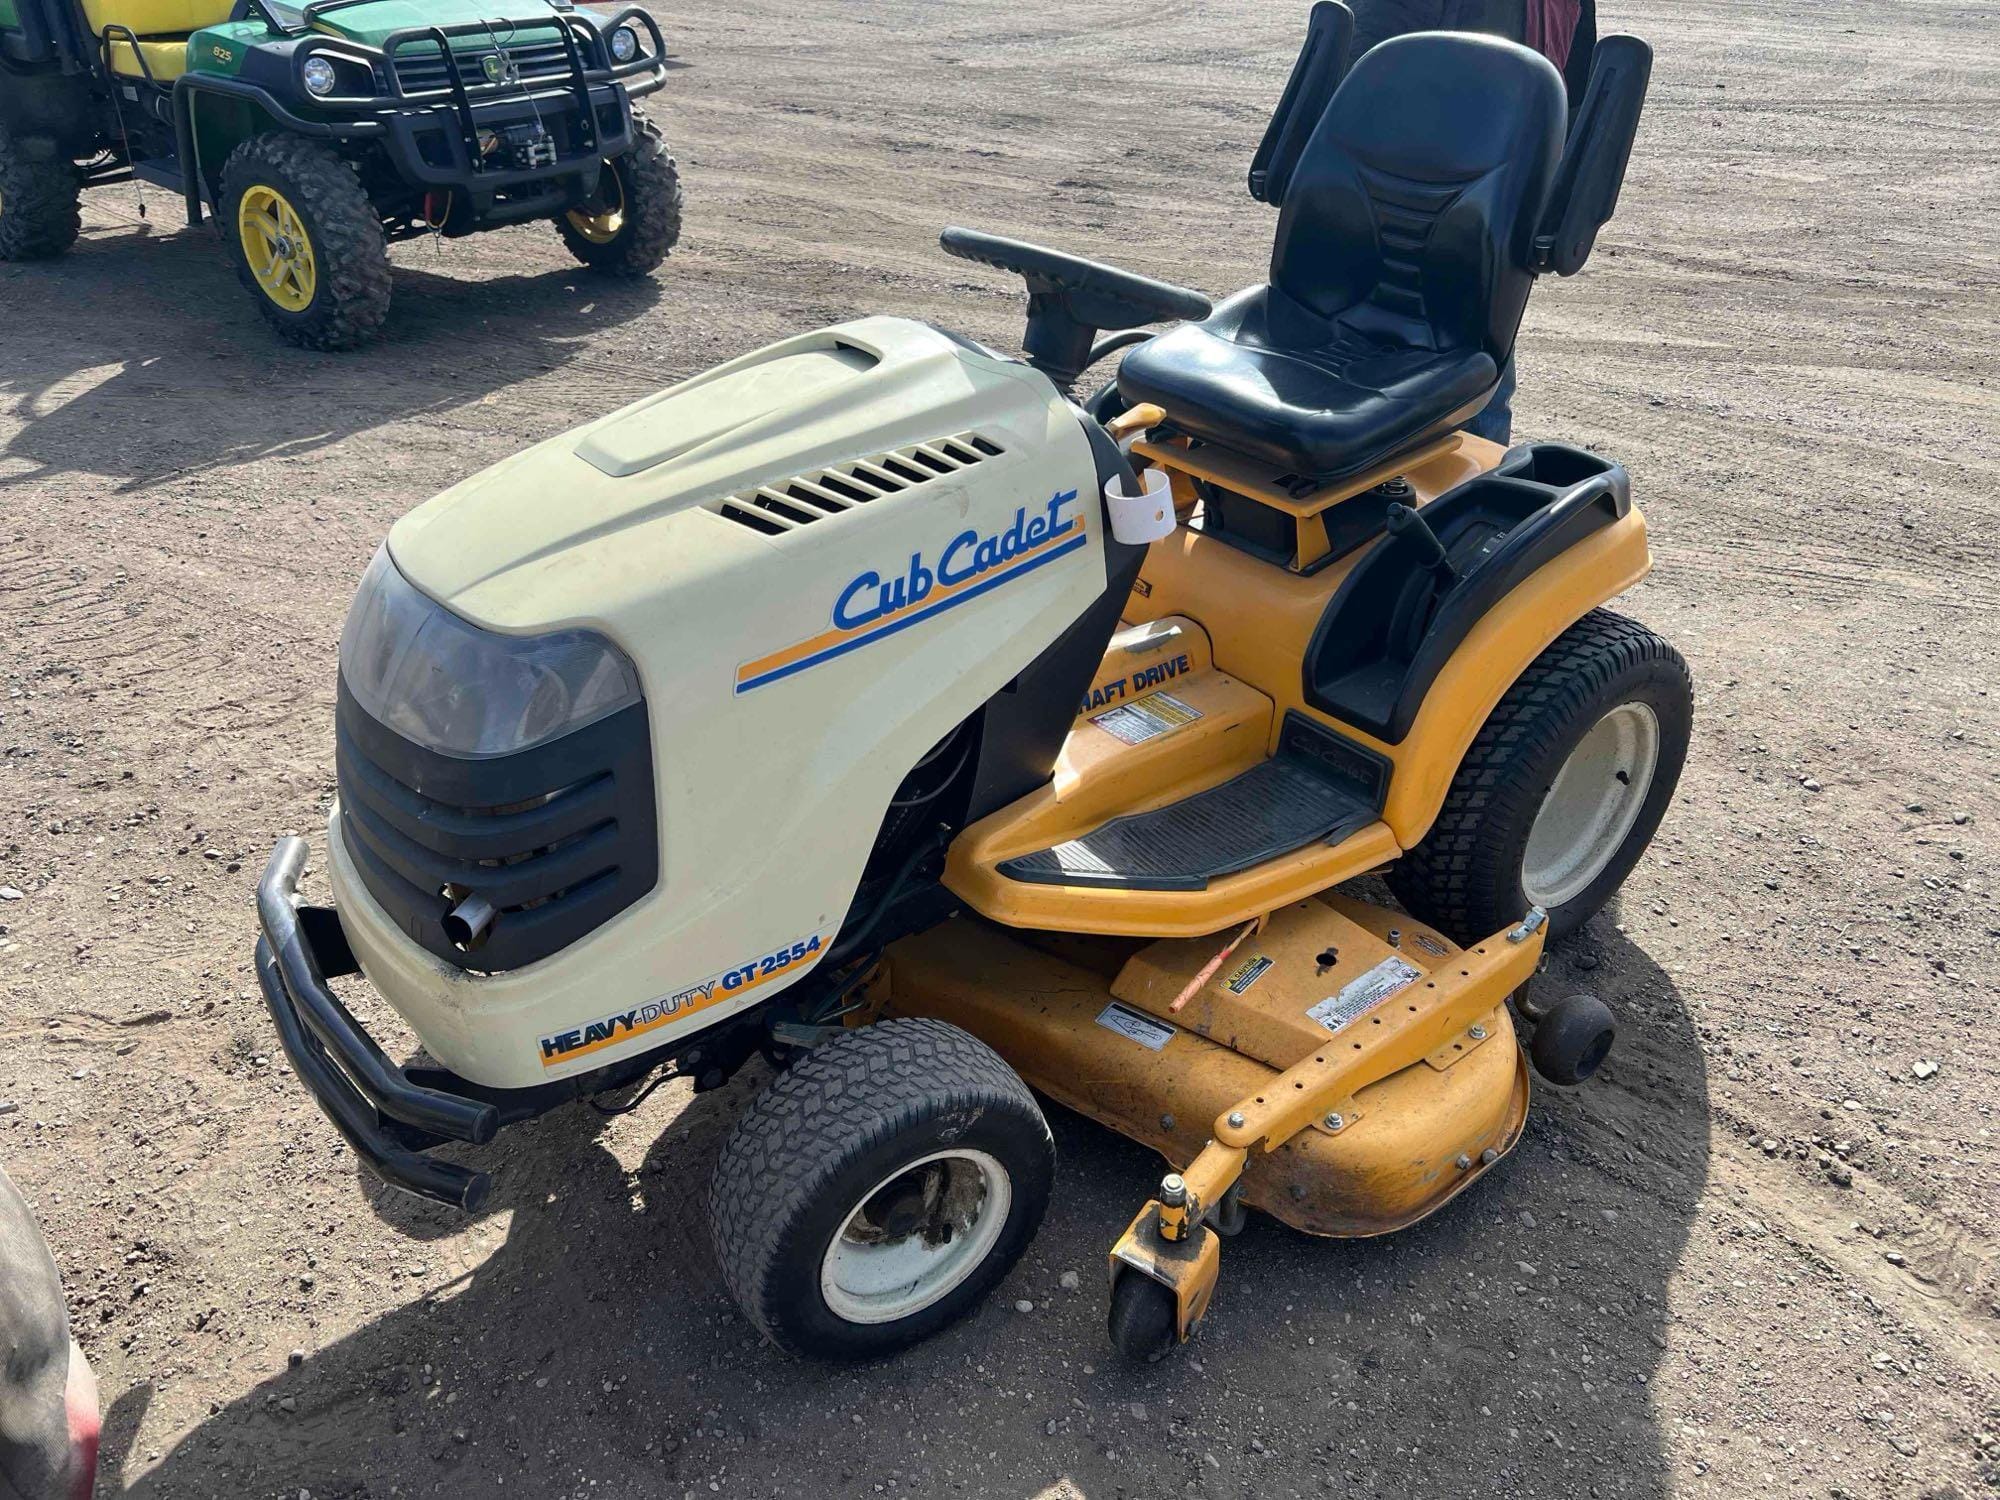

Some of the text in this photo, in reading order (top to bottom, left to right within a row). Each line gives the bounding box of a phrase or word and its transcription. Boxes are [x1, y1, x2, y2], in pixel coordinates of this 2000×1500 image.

[833, 489, 1078, 630] Cub Cadet
[1079, 655, 1190, 714] HAFT DRIVE
[541, 935, 821, 1058] HEAVY-DUTY GT 2554
[1234, 957, 1257, 978] CAUTION
